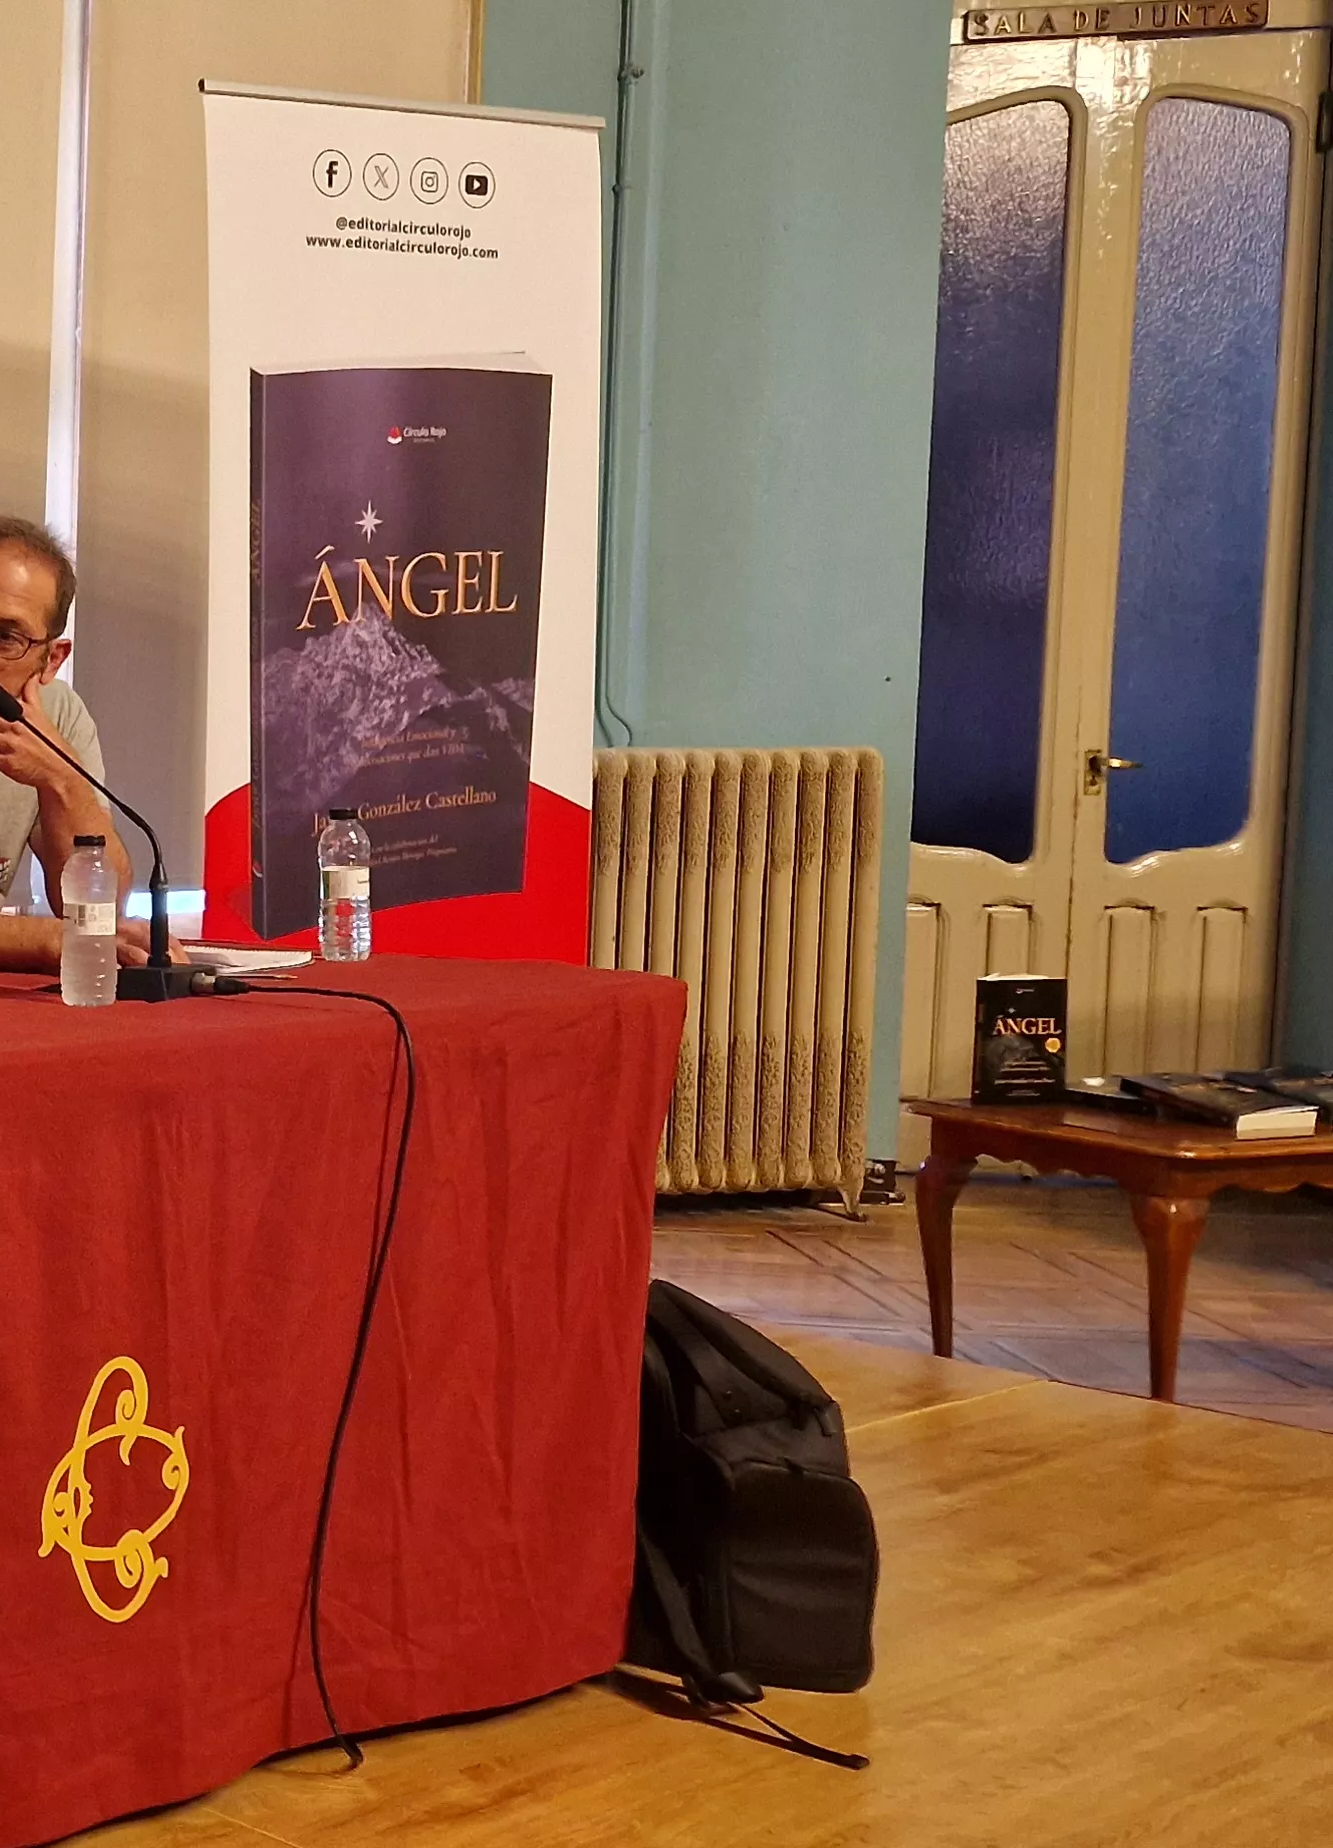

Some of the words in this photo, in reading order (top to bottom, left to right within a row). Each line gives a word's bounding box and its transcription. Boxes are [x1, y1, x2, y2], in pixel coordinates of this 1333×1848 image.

[974, 12, 1057, 36] SALA
[1074, 9, 1111, 30] DE
[1132, 2, 1259, 28] JUNTAS
[336, 217, 471, 241] @editorialcirculorojo
[306, 235, 499, 259] www.editorialcirculorojo.com
[295, 545, 518, 631] ÁNGEL
[357, 793, 421, 821] González
[425, 785, 497, 810] Castellano
[992, 1014, 1062, 1035] ÁNGEL
